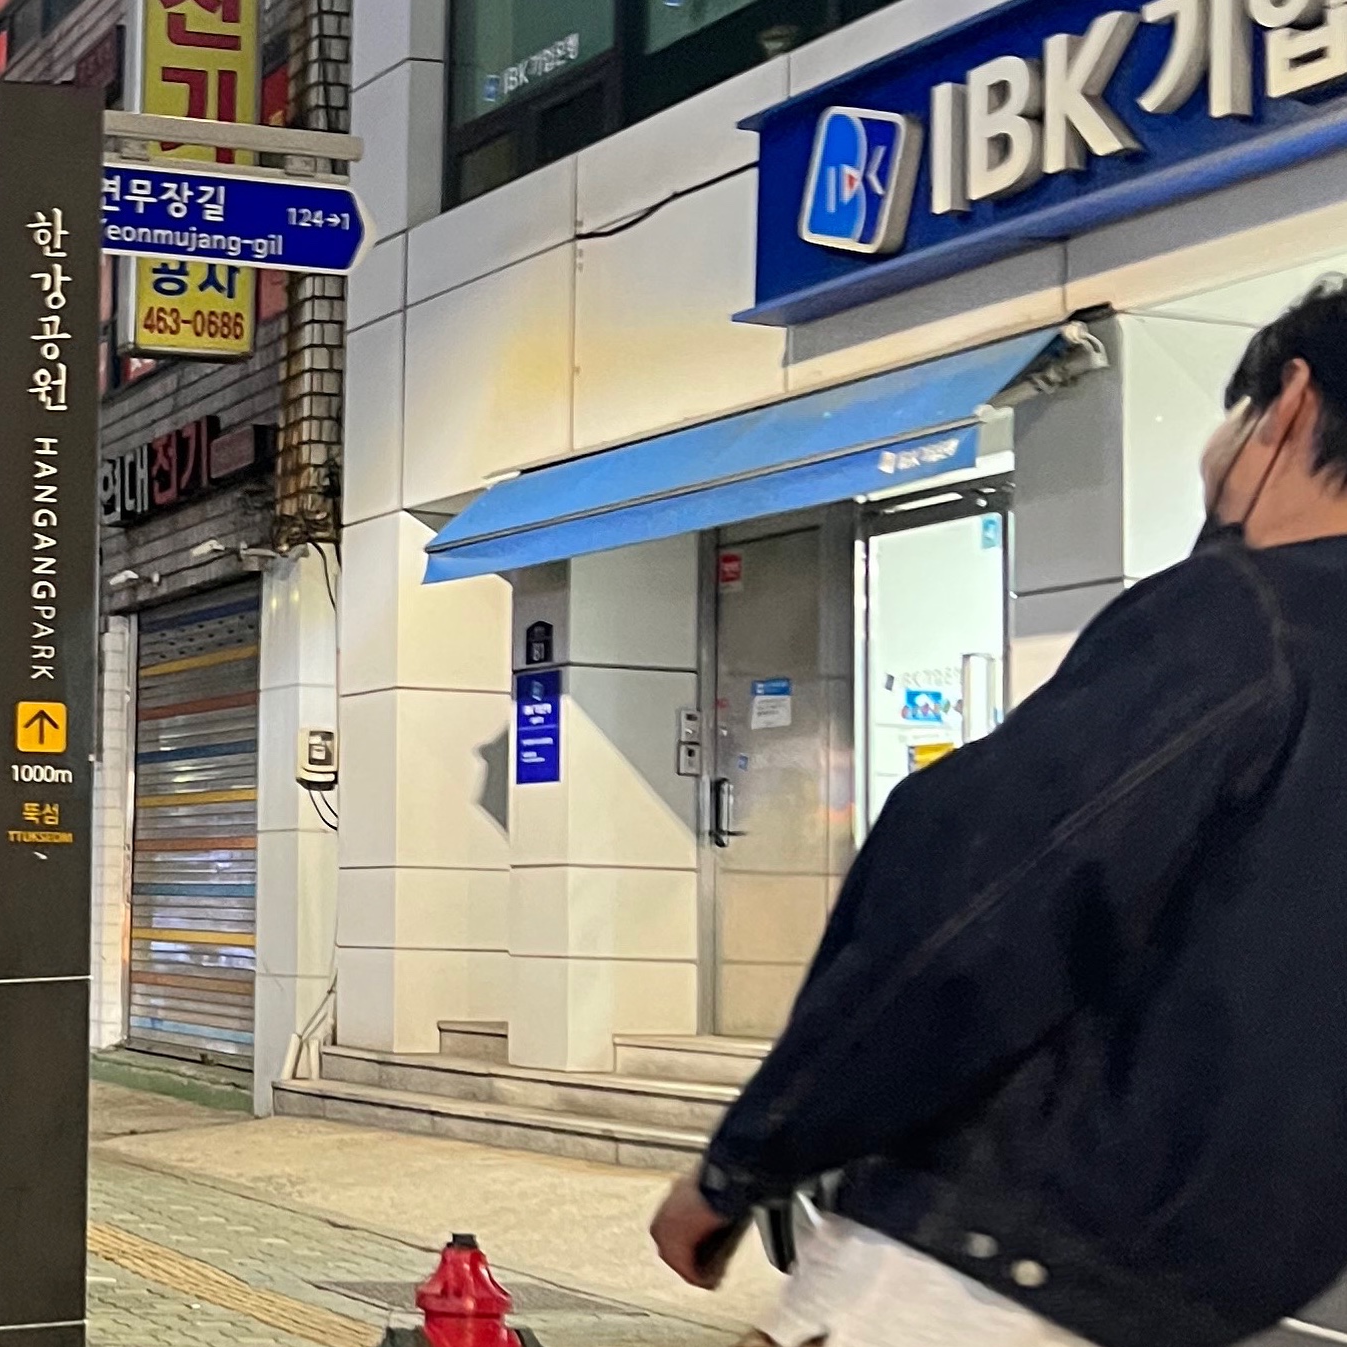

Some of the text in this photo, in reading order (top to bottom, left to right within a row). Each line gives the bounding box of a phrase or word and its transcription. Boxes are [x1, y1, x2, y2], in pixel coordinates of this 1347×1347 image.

[100, 217, 283, 259] eonmujang-gil
[26, 208, 72, 411] 한강공원
[142, 306, 244, 340] 463-0686
[30, 437, 59, 680] HANGANGPARK
[11, 764, 73, 784] 1000m
